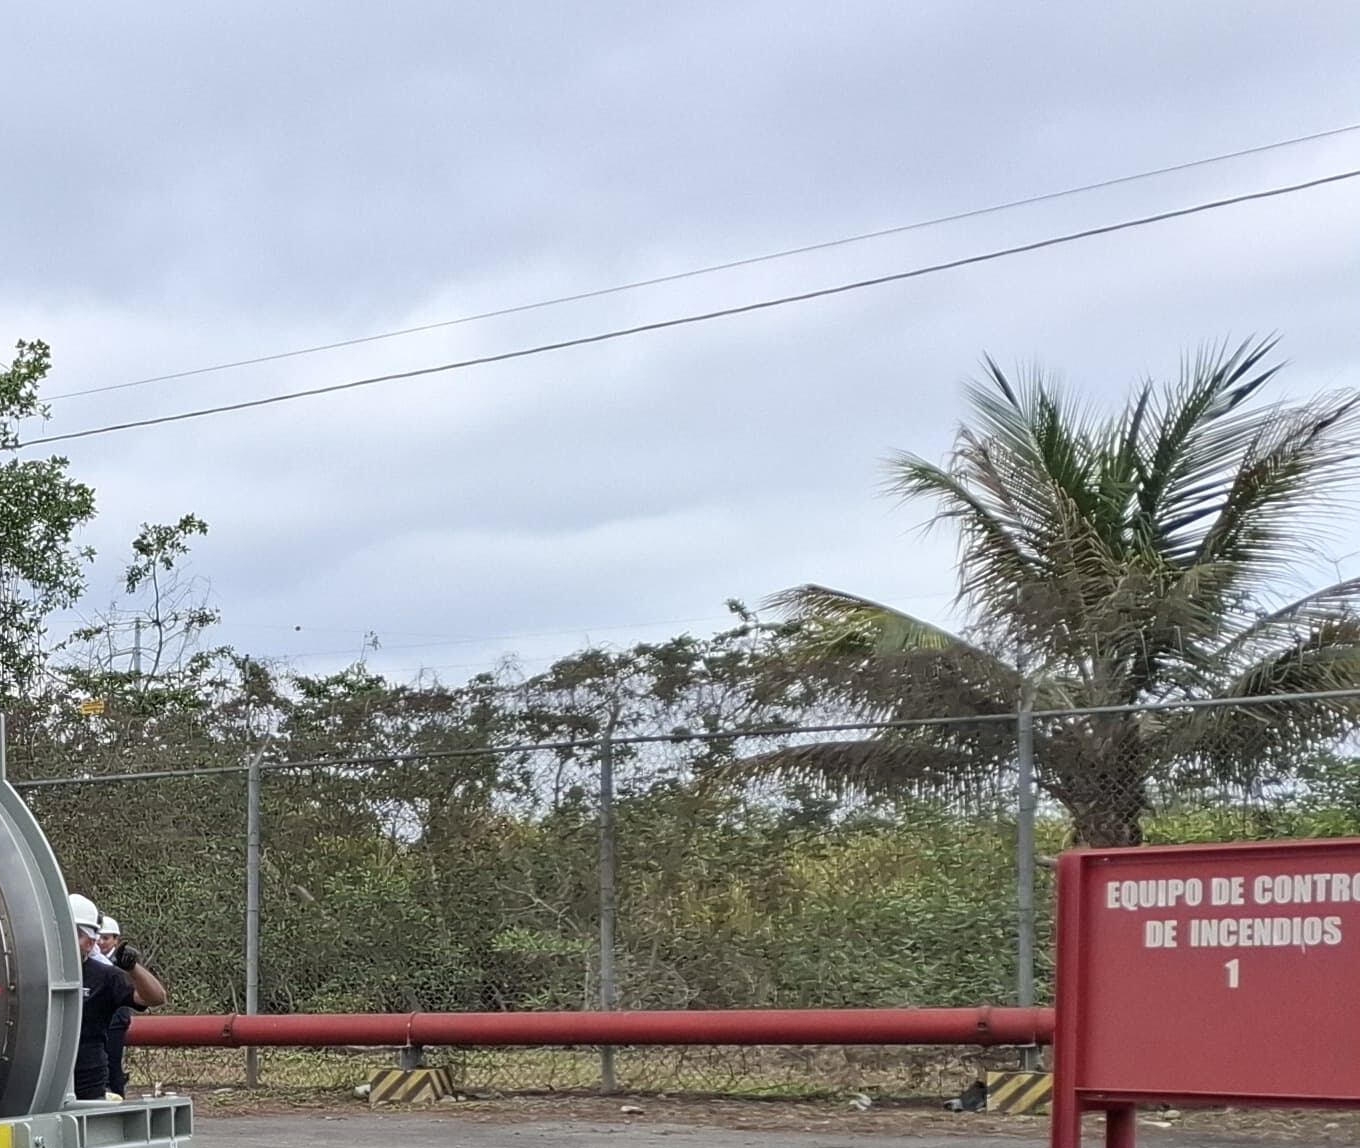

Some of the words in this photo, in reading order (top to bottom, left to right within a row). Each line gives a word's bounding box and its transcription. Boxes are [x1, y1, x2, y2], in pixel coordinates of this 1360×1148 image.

[1107, 879, 1203, 911] EQUIPO
[1211, 877, 1245, 906] DE
[1145, 920, 1177, 948] DE
[1190, 916, 1342, 947] INCENDIOS
[1225, 958, 1239, 988] 1
